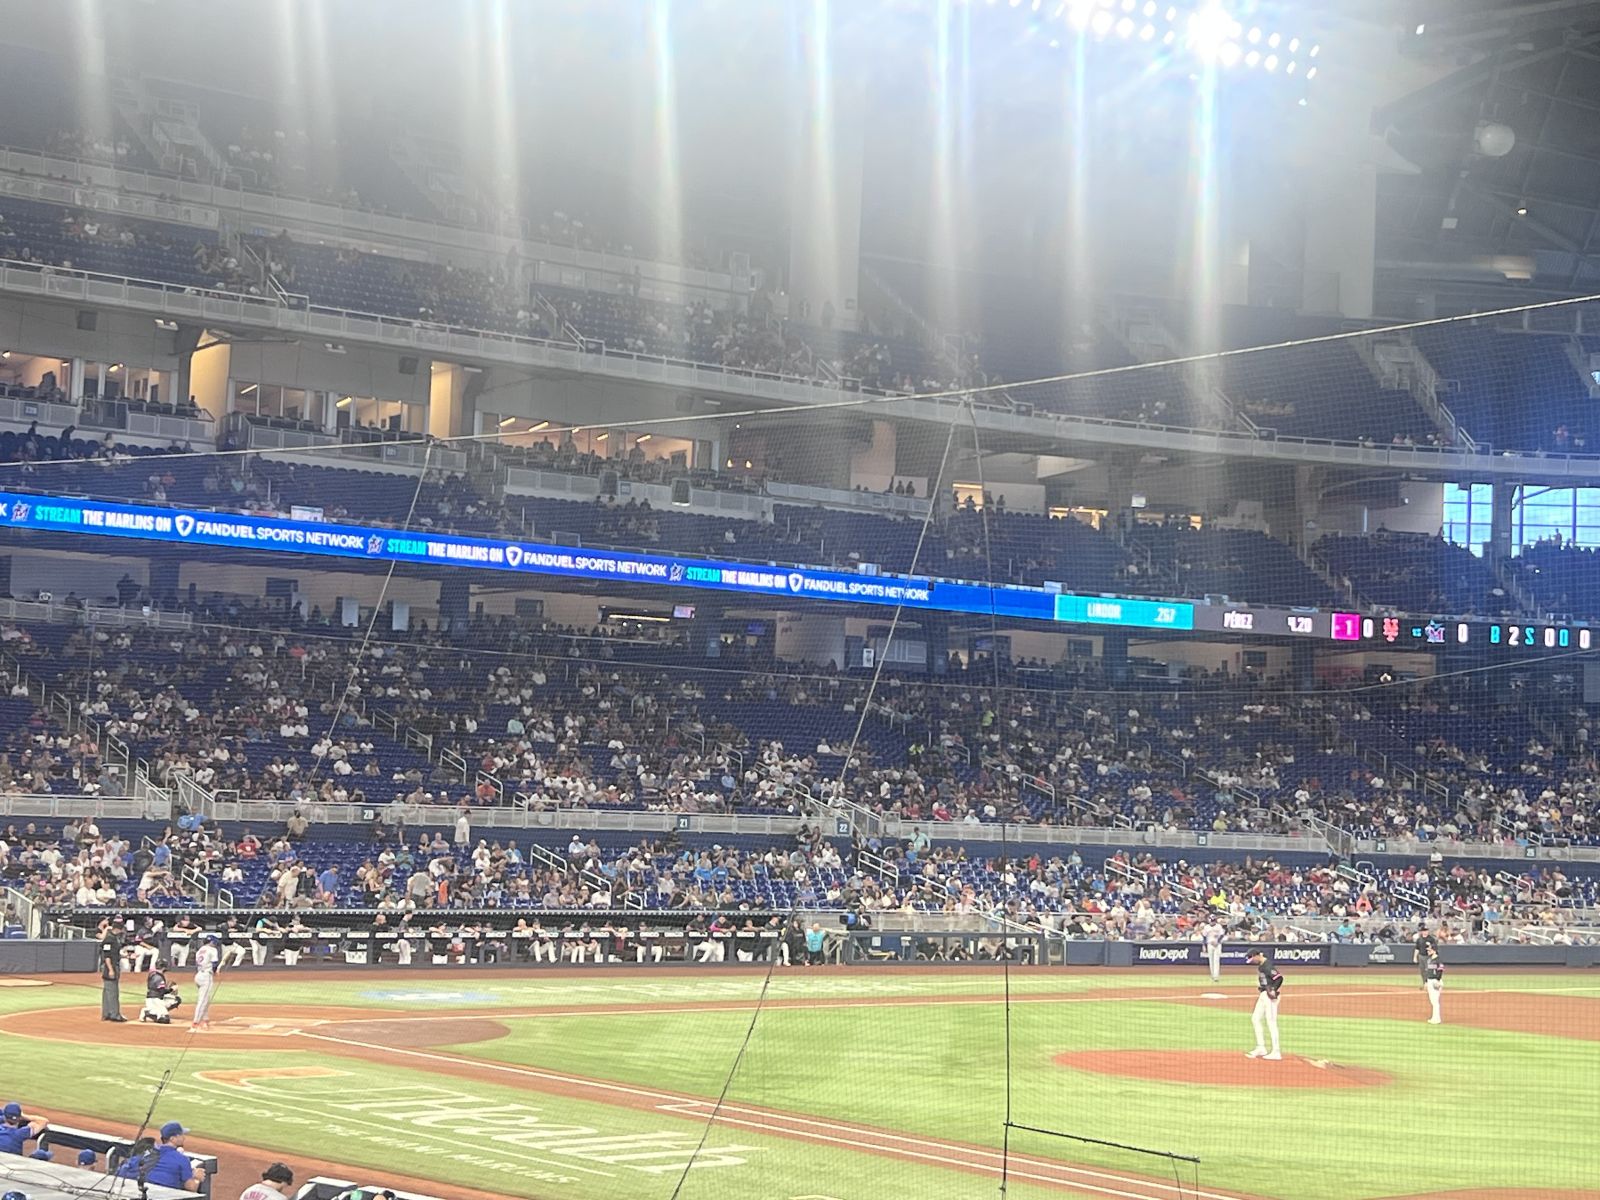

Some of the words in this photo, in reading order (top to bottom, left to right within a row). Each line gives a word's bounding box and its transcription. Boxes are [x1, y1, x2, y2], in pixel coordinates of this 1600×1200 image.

[35, 505, 80, 523] STREAM
[82, 509, 105, 526] THE
[105, 512, 154, 531] MARLINS
[155, 517, 171, 533] ON
[196, 521, 256, 539] FANDUEL
[256, 527, 304, 543] SPORTS
[306, 532, 364, 549] NETWORK
[387, 538, 426, 556] STREAM
[427, 542, 446, 557] THE
[447, 544, 488, 562] MARLINS
[489, 548, 504, 563] ON
[523, 552, 575, 569] FANDUEL
[575, 557, 615, 573] SPORTS
[617, 561, 667, 577] NETWORK
[686, 566, 720, 583] STREAM
[721, 569, 738, 585] THE
[737, 571, 774, 588] MARLINS
[774, 574, 787, 589] ON
[804, 578, 849, 594] FANDUEL
[848, 582, 885, 597] SPORTS
[885, 586, 930, 601] NETWORK
[1363, 618, 1373, 638] 0
[1458, 623, 1468, 643] 0
[1508, 626, 1519, 646] 2
[1544, 628, 1555, 647] 0
[1579, 629, 1591, 649] 0
[1139, 947, 1189, 962] loanDepot
[1273, 947, 1321, 962] loanDepot
